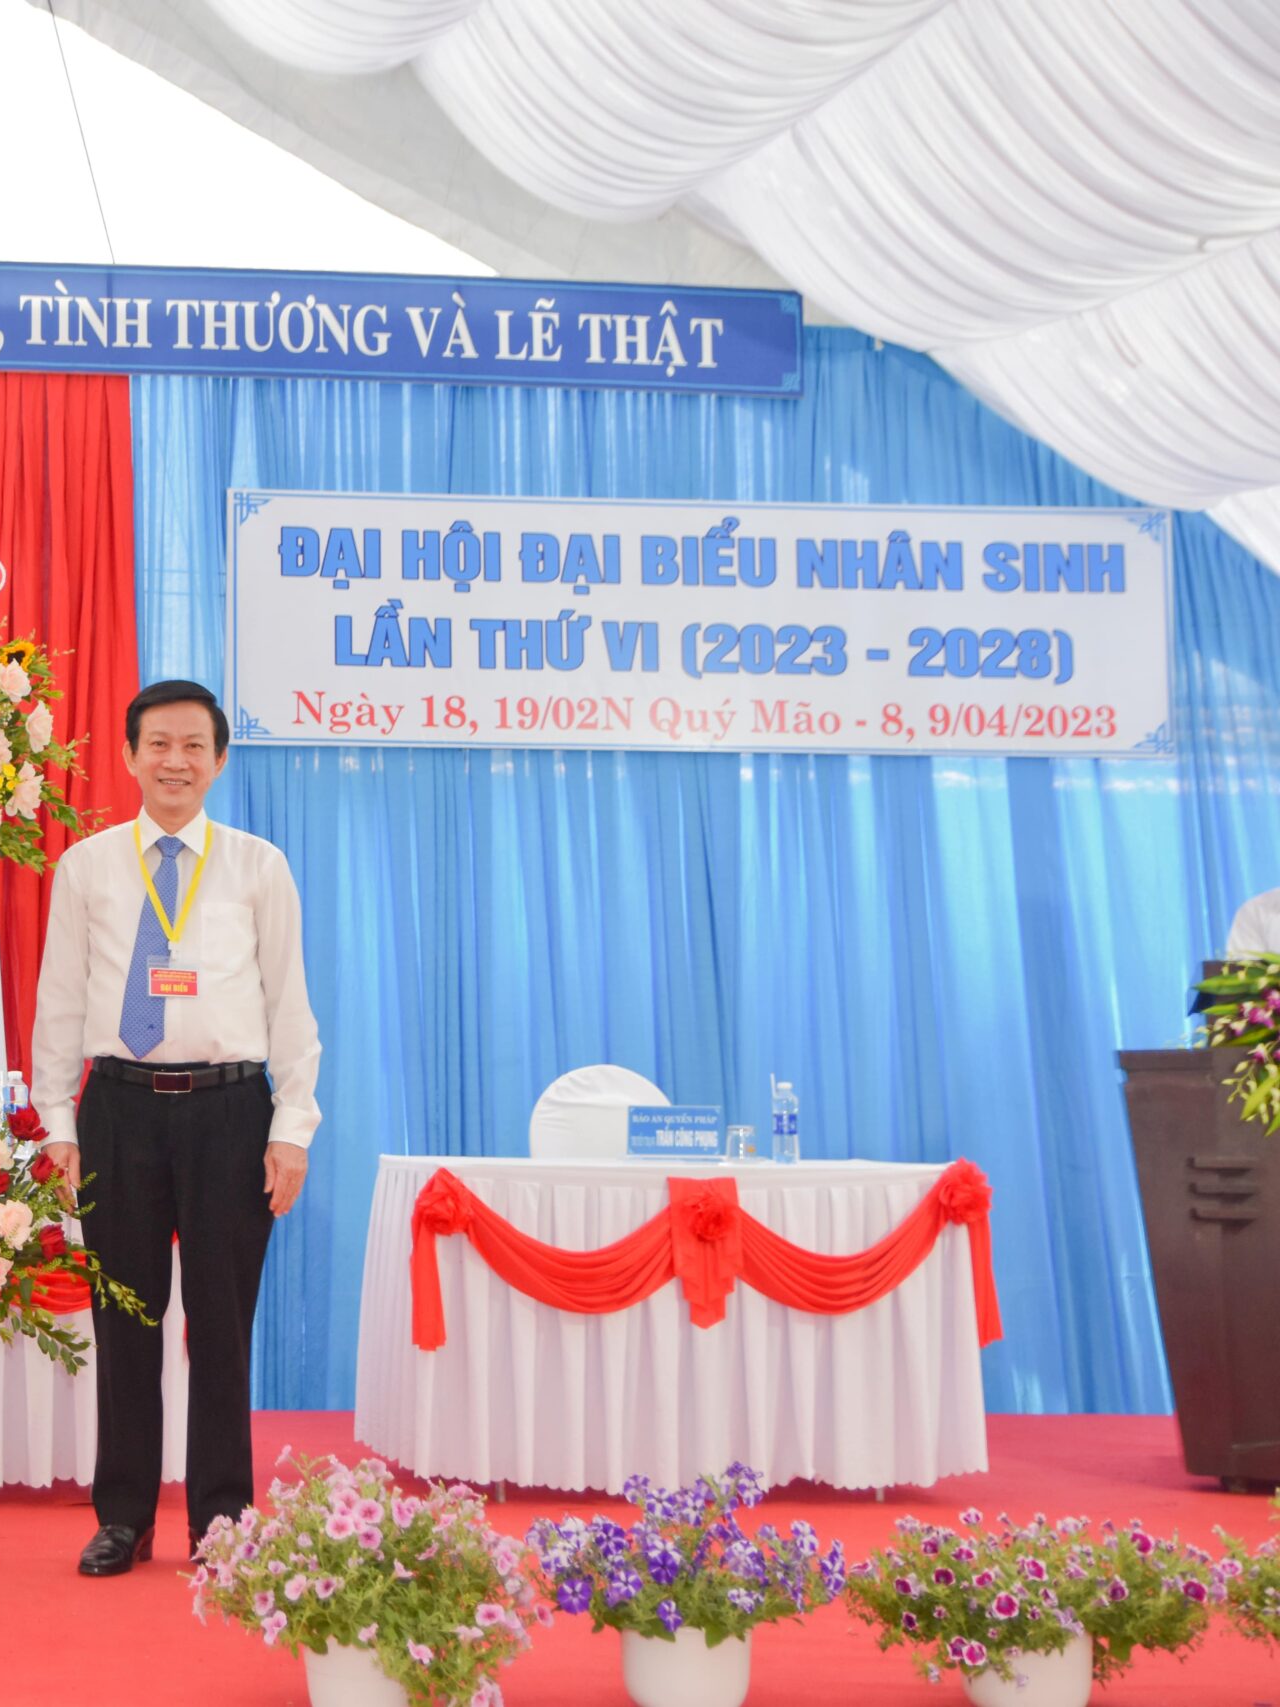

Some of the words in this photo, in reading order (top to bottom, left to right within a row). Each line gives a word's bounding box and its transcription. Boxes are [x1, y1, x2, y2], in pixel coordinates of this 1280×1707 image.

[19, 279, 152, 348] TÌNH
[166, 291, 392, 356] THƯƠNG
[405, 291, 479, 359] VÀ
[494, 297, 563, 362] LẼ
[578, 300, 724, 378] THẬT
[278, 526, 381, 589] ĐẠI
[402, 520, 501, 592] HỘI
[519, 532, 621, 595] ĐẠI
[641, 516, 777, 588] BIỂU
[796, 529, 963, 591] NHÂN
[982, 541, 1126, 593] SINH
[335, 599, 452, 668] LẦN
[470, 609, 592, 671] THỨ
[601, 621, 660, 672] VI
[681, 622, 848, 680] (2023
[866, 649, 890, 661] -
[908, 627, 1074, 685] 2028)
[292, 690, 405, 735] Ngày
[421, 695, 479, 736] 18,
[495, 696, 634, 731] 19/02N
[649, 696, 736, 740] Quý
[750, 698, 842, 734] Mão
[881, 702, 915, 743] 8,
[928, 703, 1117, 738] 9/04/2023
